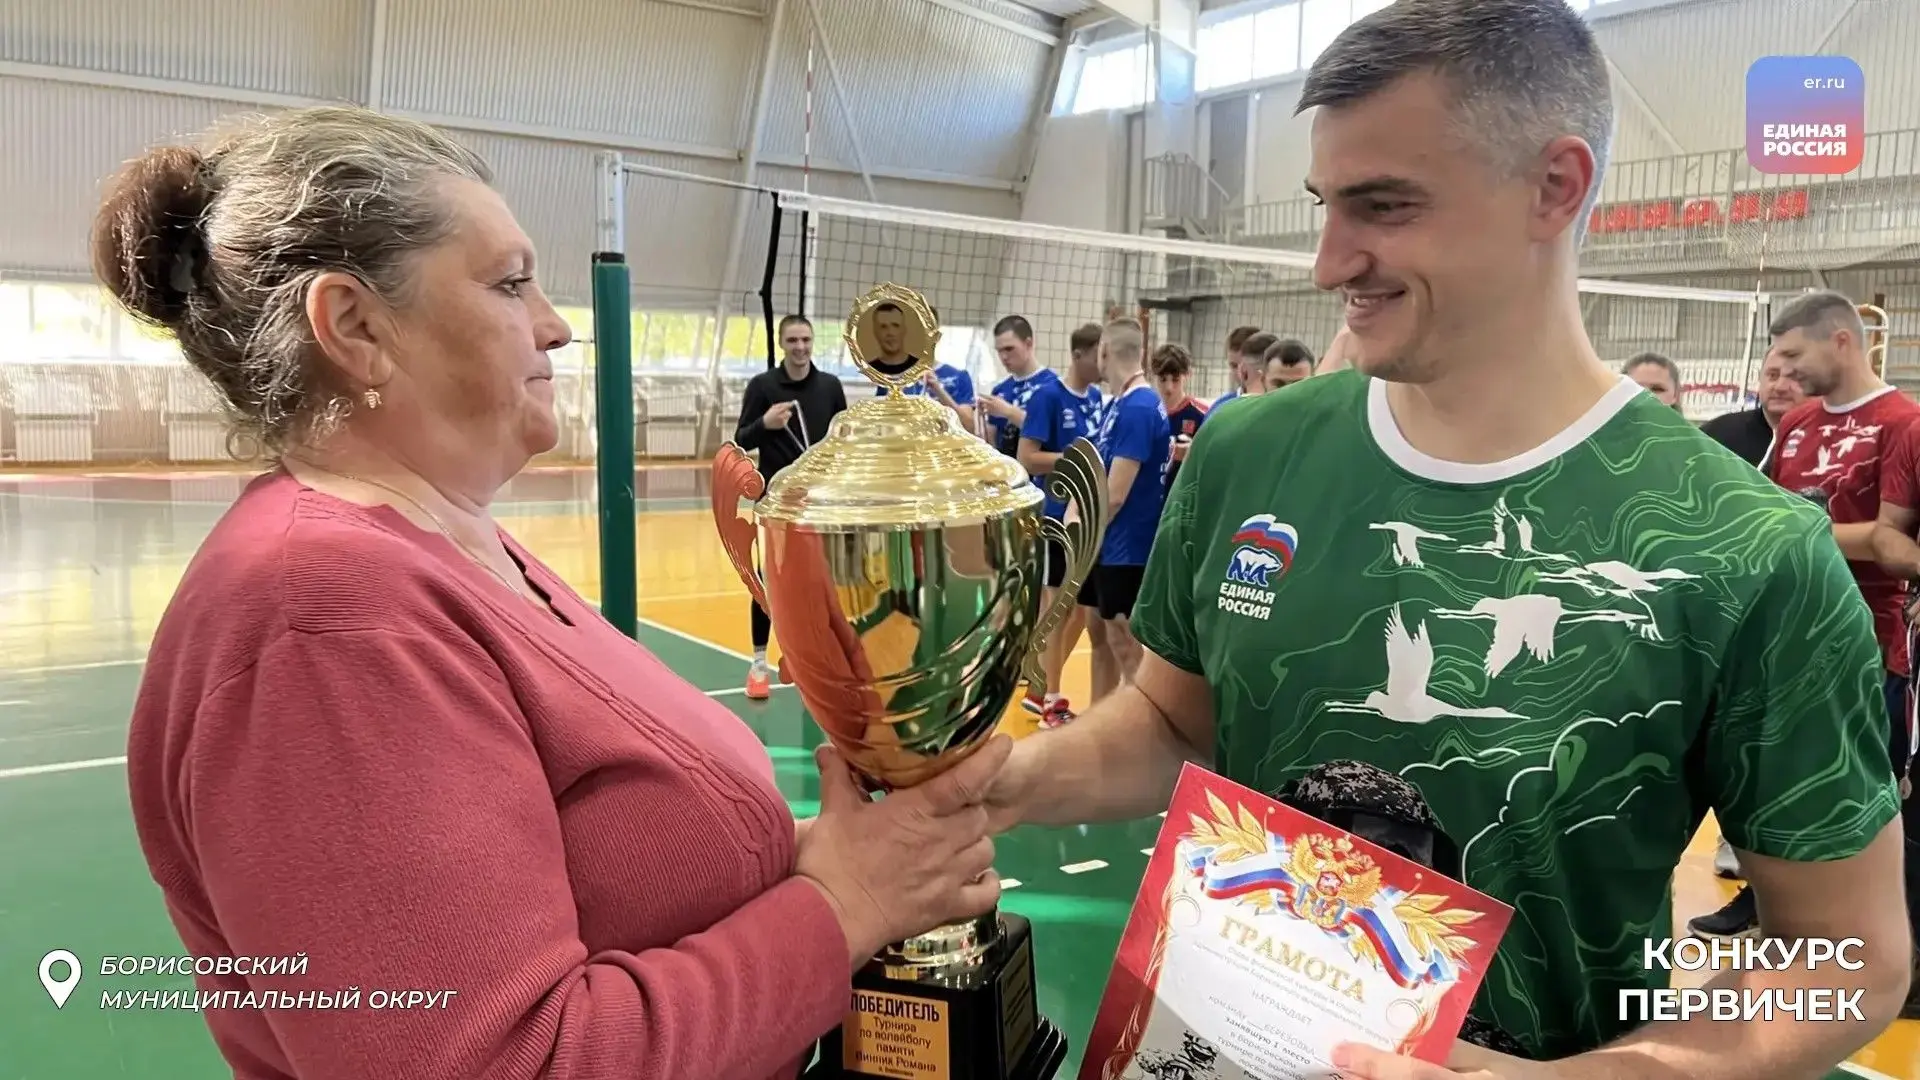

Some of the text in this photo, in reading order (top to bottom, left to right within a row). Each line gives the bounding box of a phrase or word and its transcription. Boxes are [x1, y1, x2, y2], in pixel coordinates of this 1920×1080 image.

[1220, 582, 1276, 604] ЕДИНАЯ
[1218, 597, 1271, 620] РОССИЯ
[1219, 914, 1364, 1003] ГРАМОТА
[851, 993, 940, 1022] ПОБЕДИТЕЛЬ
[873, 1016, 917, 1033] Турнира
[859, 1028, 932, 1049] по волейболу
[876, 1043, 915, 1057] памяти
[896, 1056, 937, 1072] Романа
